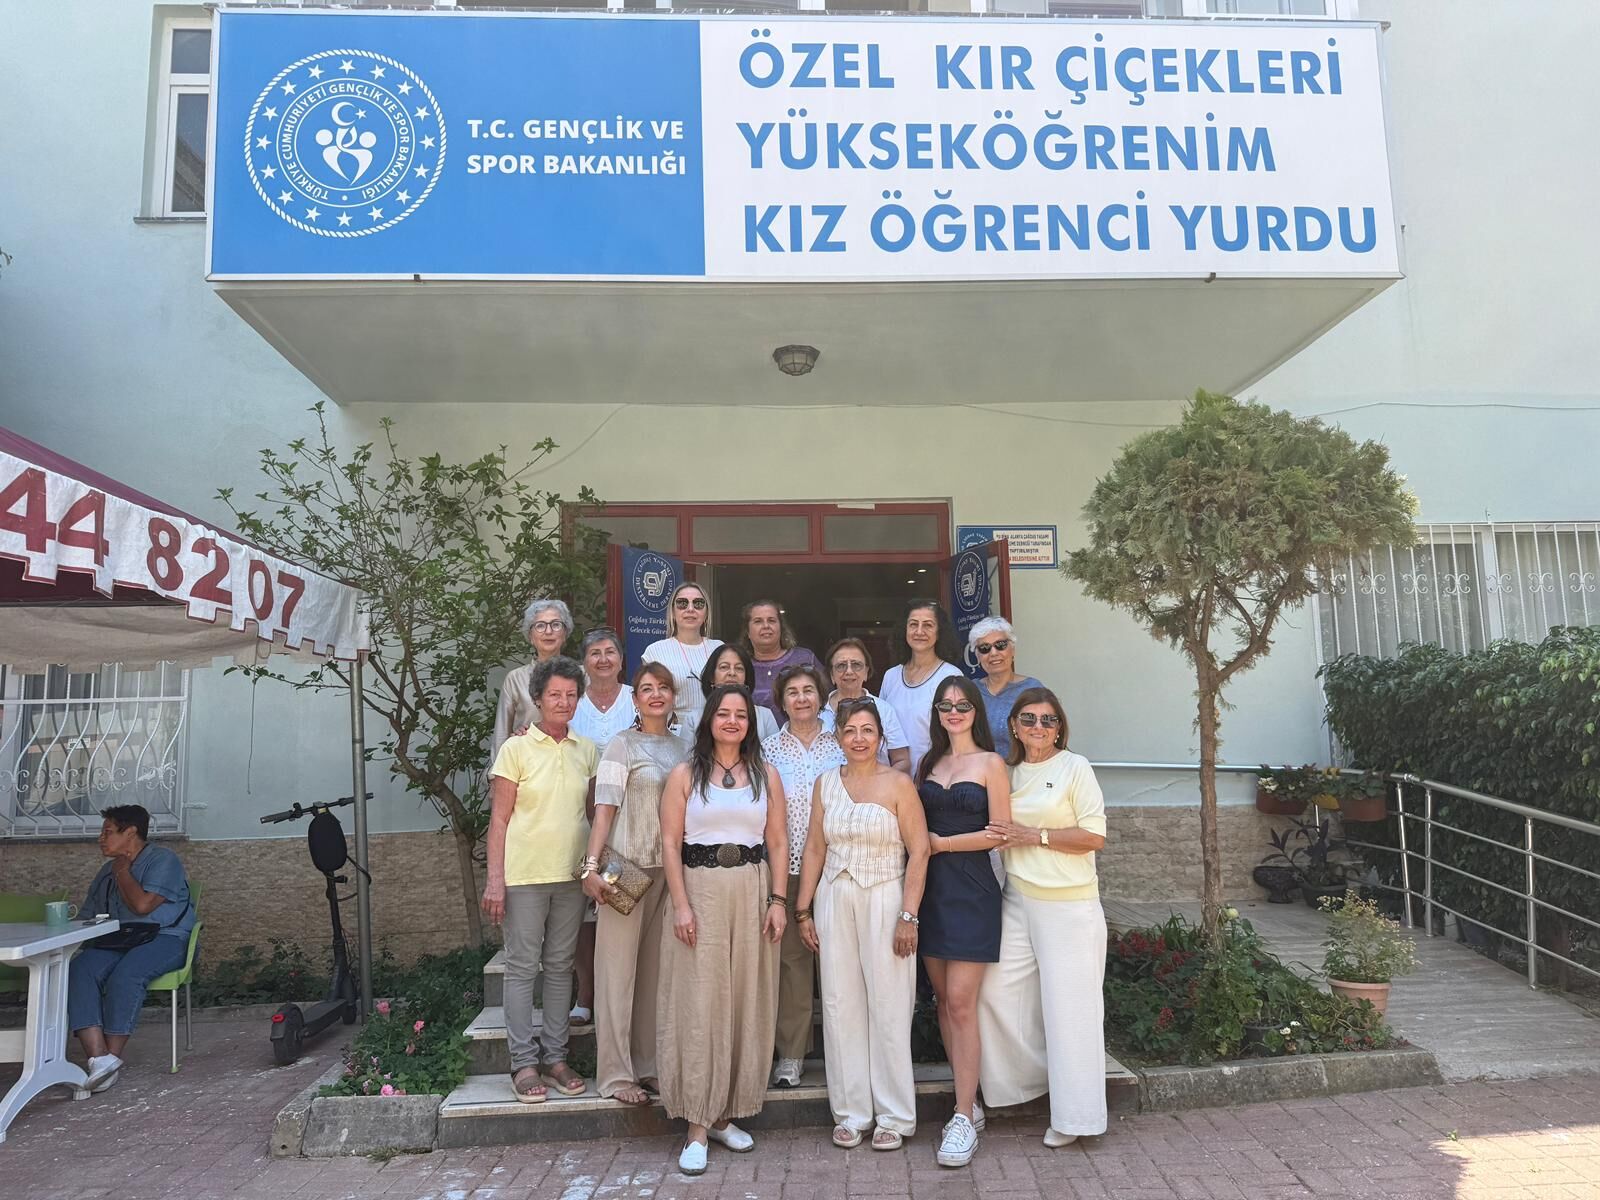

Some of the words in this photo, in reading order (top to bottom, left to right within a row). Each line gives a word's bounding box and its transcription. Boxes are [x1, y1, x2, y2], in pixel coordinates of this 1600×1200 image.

[739, 29, 894, 90] ÖZEL
[936, 45, 1036, 92] KIR
[1056, 33, 1343, 107] ÇİÇEKLERİ
[329, 82, 384, 102] GENÇLİK
[382, 97, 398, 113] VE
[281, 86, 326, 161] CUMHURİYETİ
[393, 112, 410, 144] SPOR
[468, 119, 514, 140] T.C.
[524, 115, 644, 145] GENÇLİK
[651, 120, 685, 141] VE
[737, 108, 1277, 172] YÜKSEKÖĞRENİM
[286, 161, 329, 201] TÜRKİYE
[361, 146, 410, 200] BAKANLIĞI
[467, 154, 537, 175] SPOR
[544, 150, 687, 176] BAKANLIĞI
[744, 204, 848, 253] KIZ
[870, 191, 1151, 253] ÖĞRENCİ
[1169, 205, 1377, 254] YURDU
